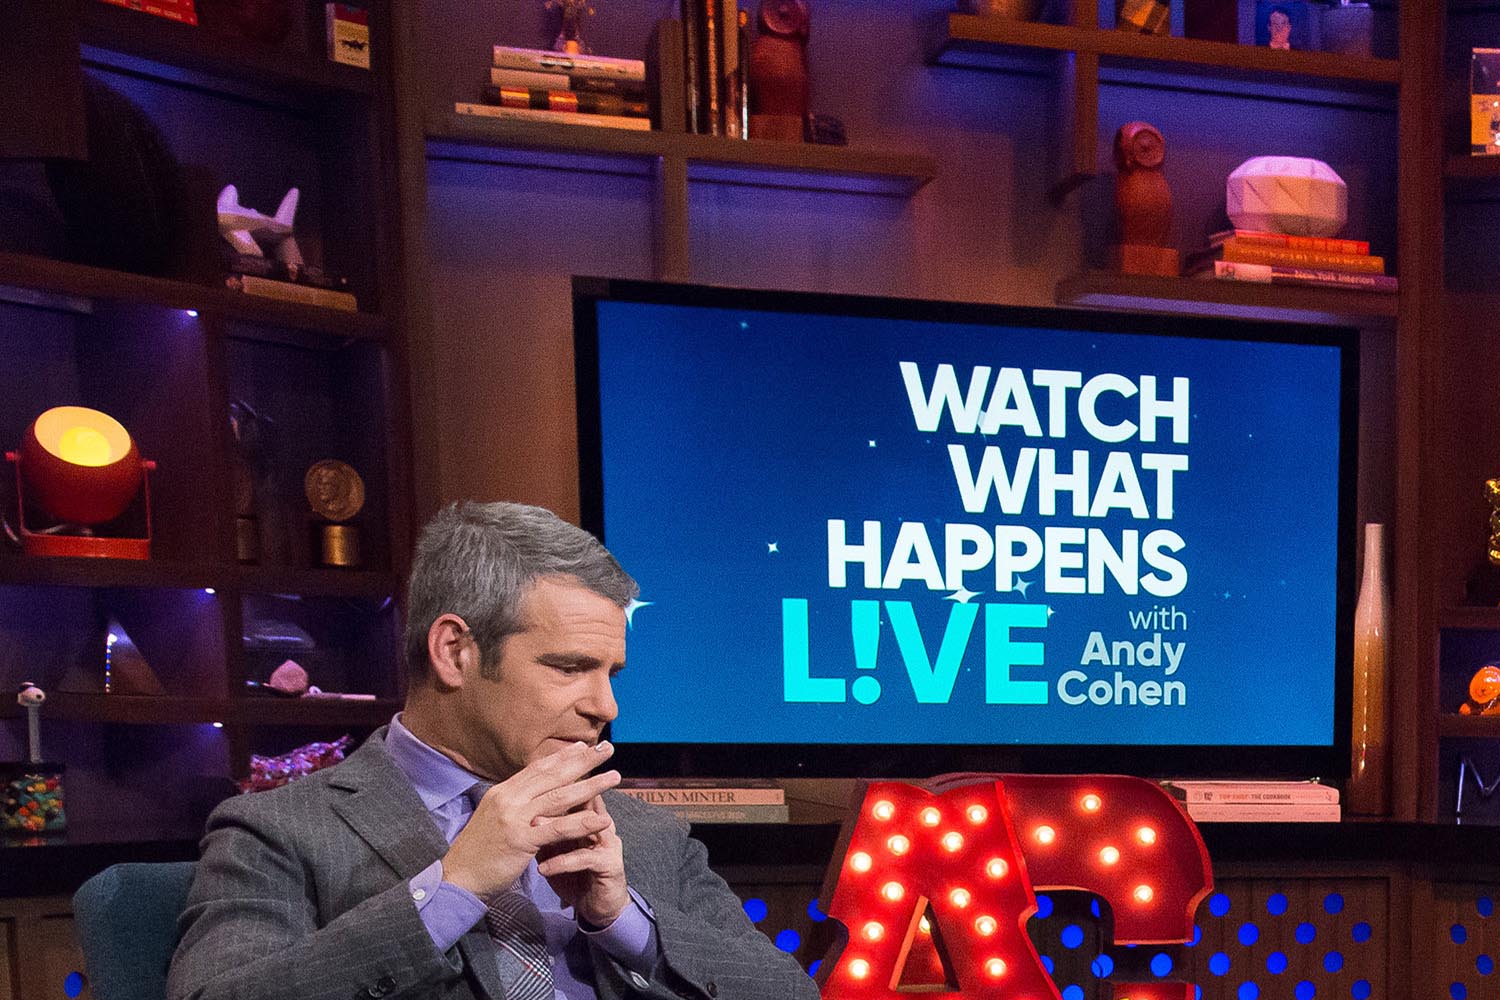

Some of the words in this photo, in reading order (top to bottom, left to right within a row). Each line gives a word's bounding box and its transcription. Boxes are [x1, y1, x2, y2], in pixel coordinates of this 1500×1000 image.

[899, 361, 1189, 443] WATCH
[947, 444, 1189, 519] WHAT
[827, 519, 1188, 597] HAPPENS
[782, 598, 1049, 705] L!VE
[1129, 605, 1187, 630] with
[1056, 670, 1186, 706] Cohen
[1080, 631, 1186, 675] Andy
[628, 791, 678, 803] ARILYN
[682, 791, 736, 803] MINTER
